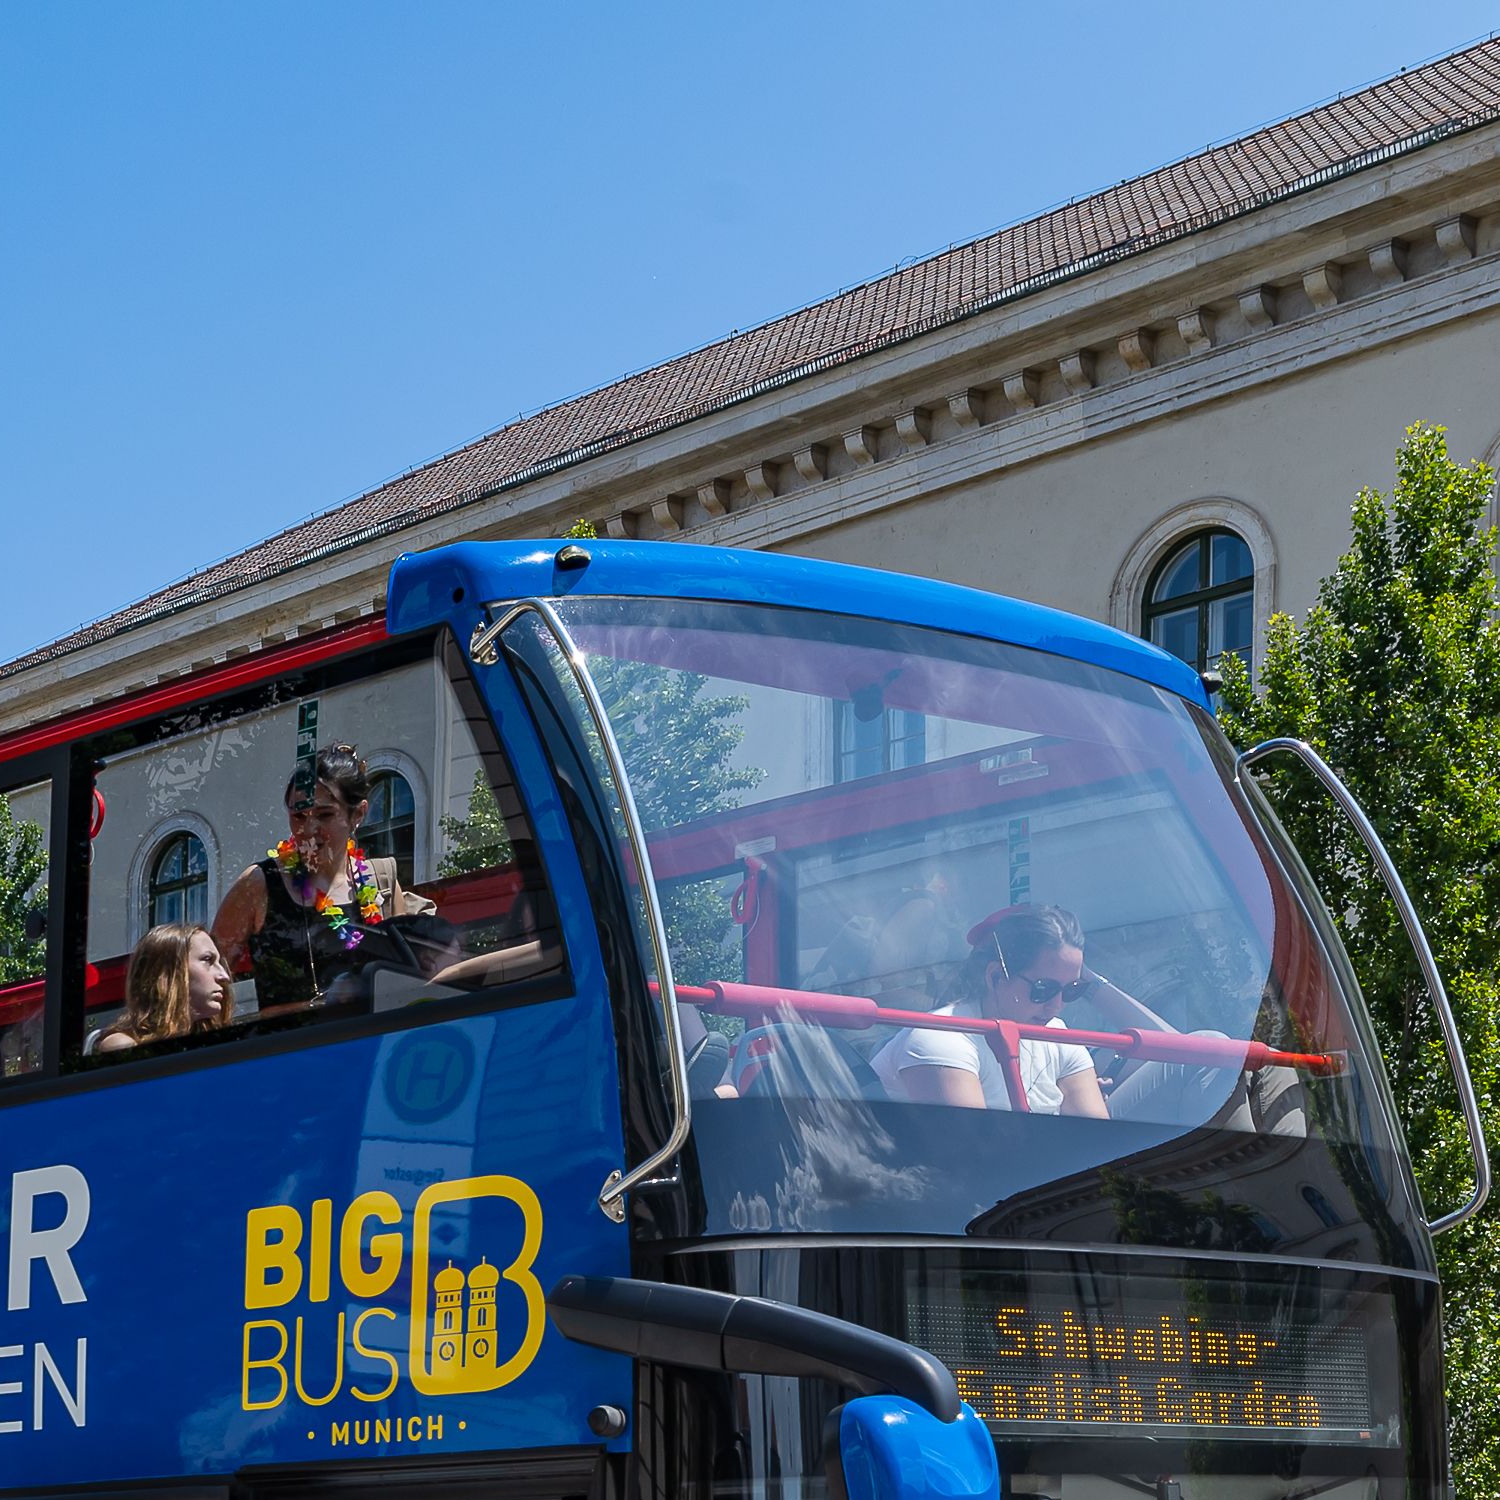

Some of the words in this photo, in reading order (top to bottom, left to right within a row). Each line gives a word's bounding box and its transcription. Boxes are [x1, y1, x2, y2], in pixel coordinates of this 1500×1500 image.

[244, 1190, 403, 1310] BIG
[241, 1307, 399, 1411] BUS
[956, 1370, 1143, 1422] English
[1157, 1377, 1320, 1427] Garden
[331, 1415, 444, 1447] MUNICH
